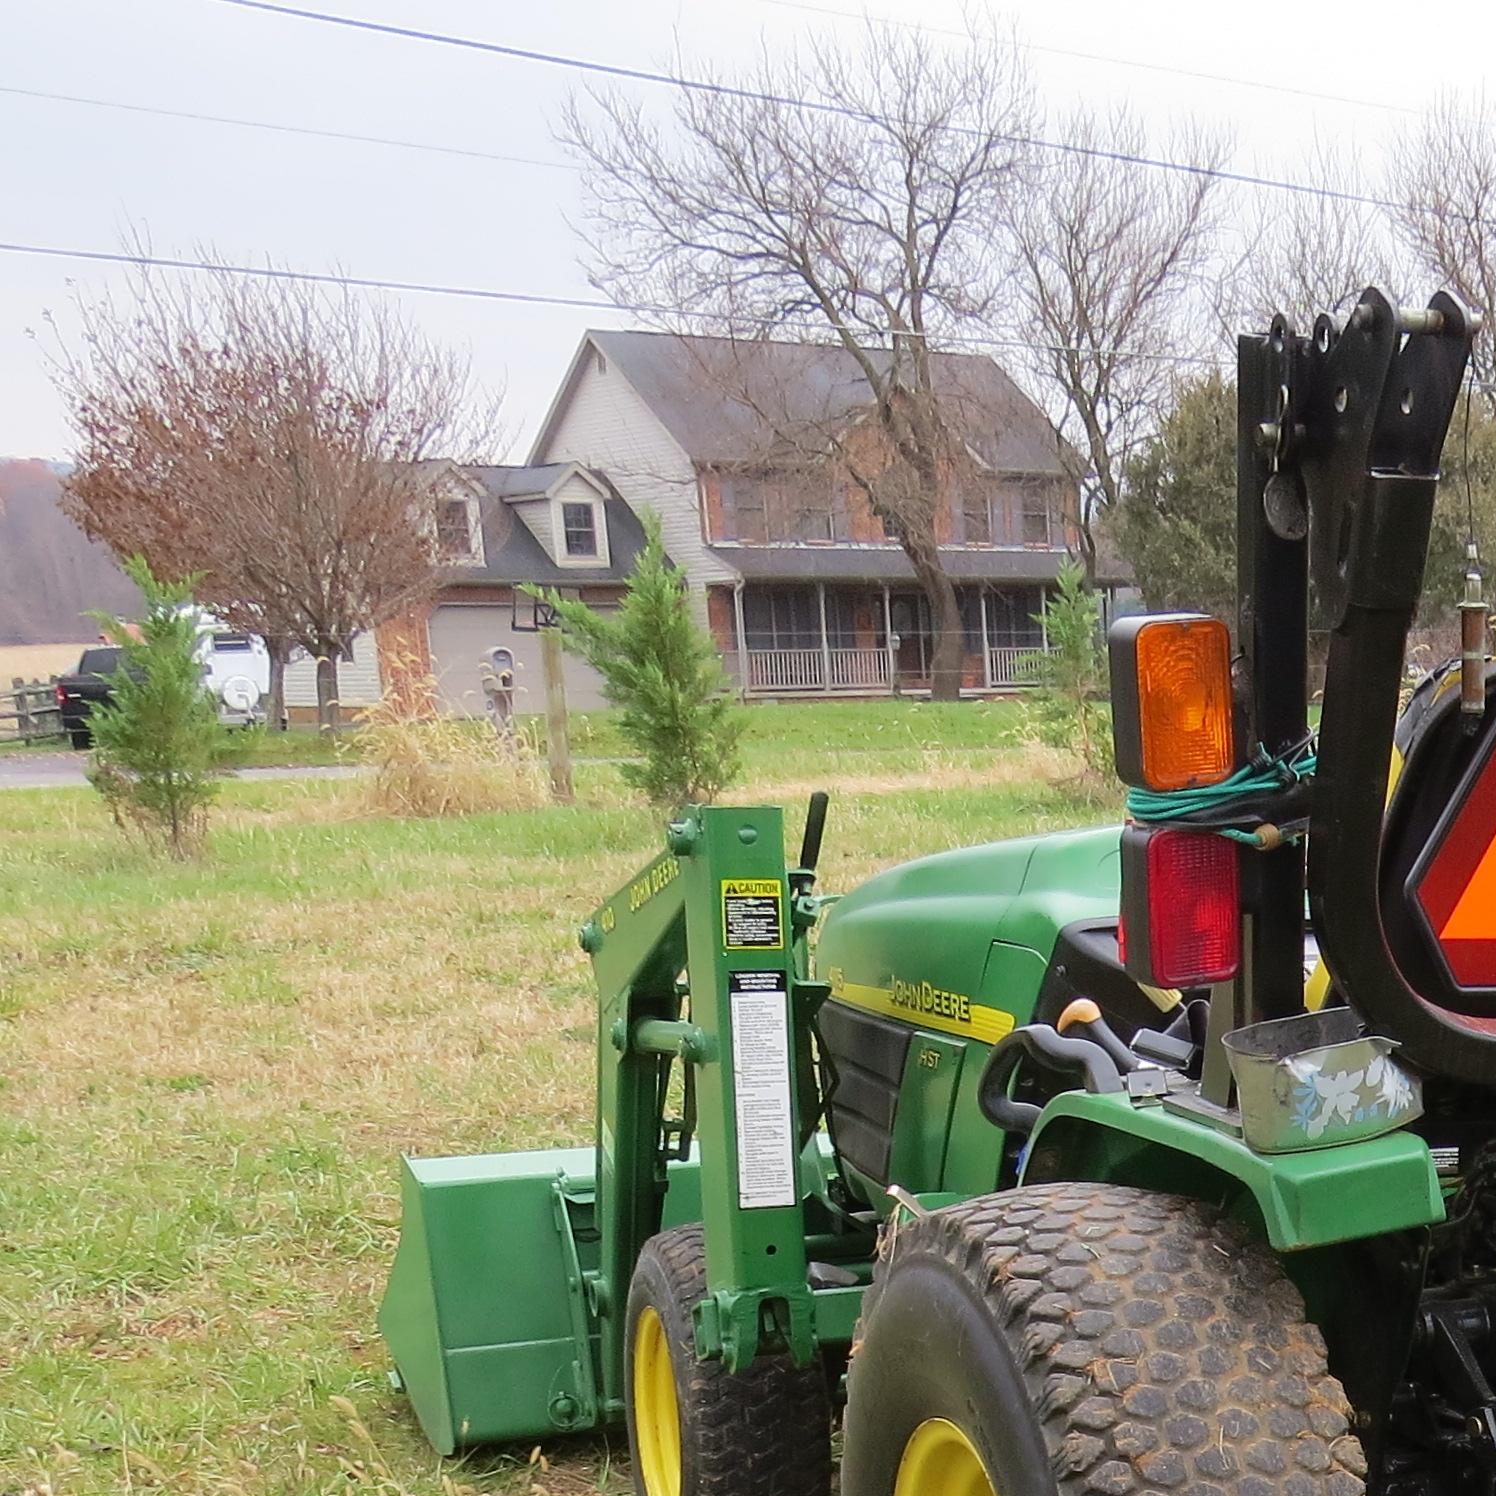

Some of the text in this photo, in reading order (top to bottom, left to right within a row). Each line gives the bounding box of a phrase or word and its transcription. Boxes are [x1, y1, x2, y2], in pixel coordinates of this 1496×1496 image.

[738, 882, 779, 894] CAUTION
[889, 974, 970, 1020] JOHN DEERE
[919, 1049, 941, 1070] HST
